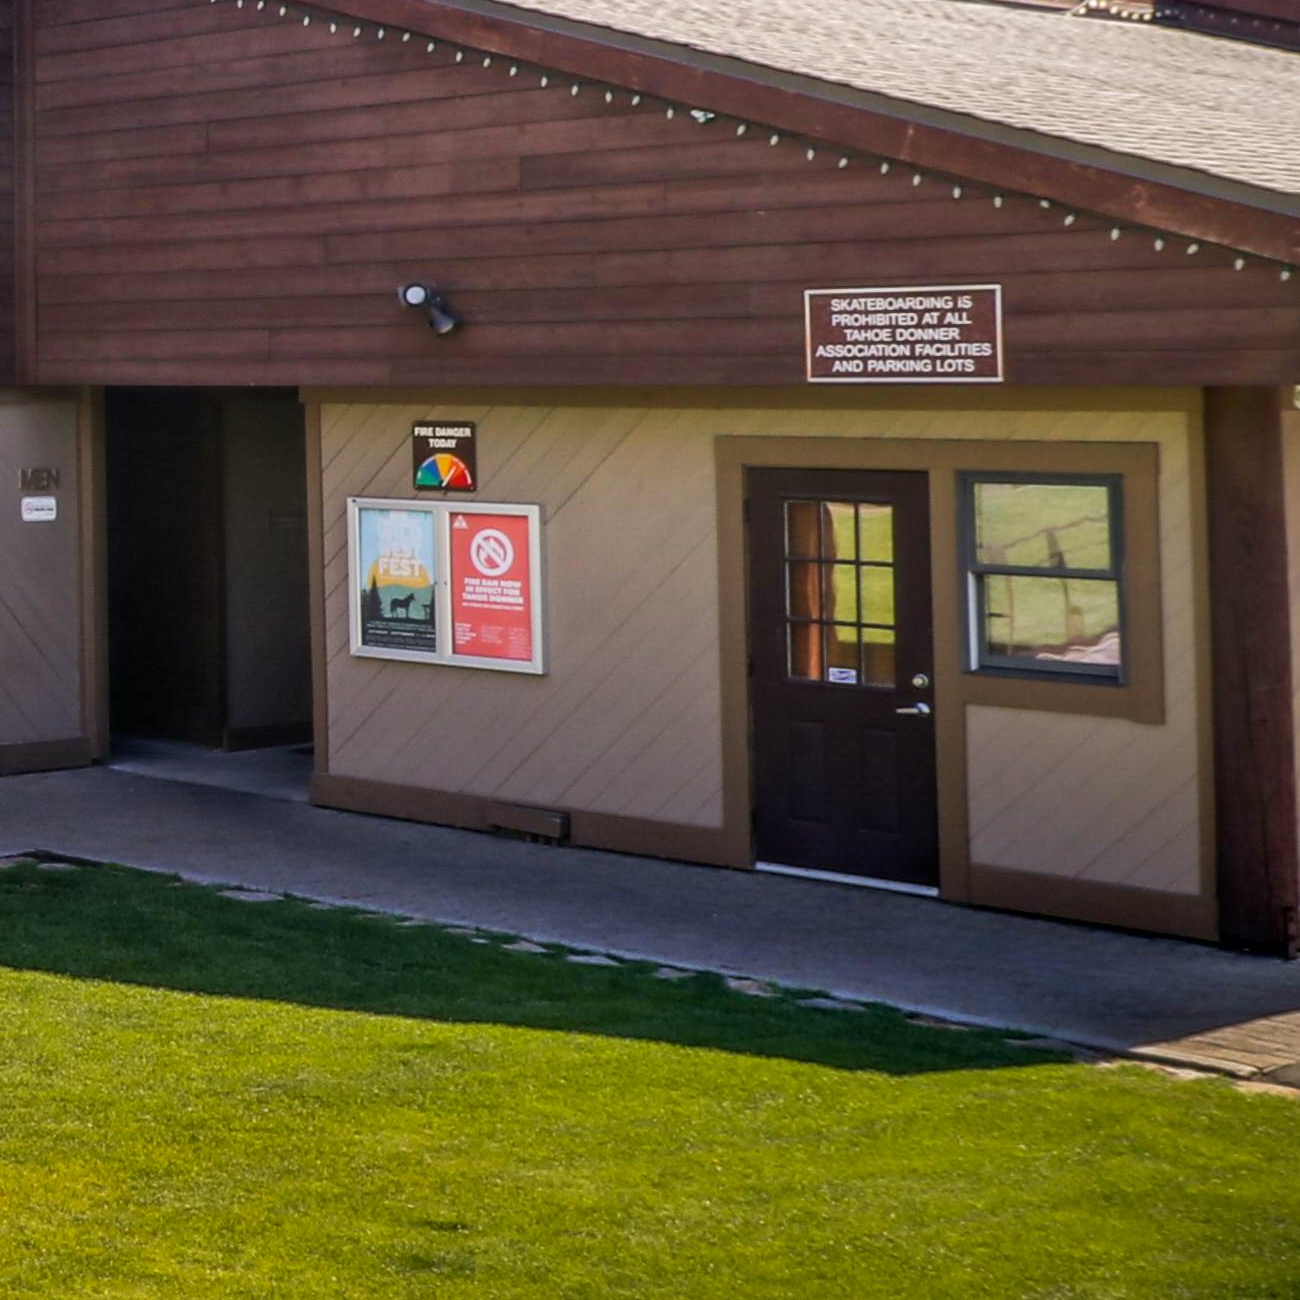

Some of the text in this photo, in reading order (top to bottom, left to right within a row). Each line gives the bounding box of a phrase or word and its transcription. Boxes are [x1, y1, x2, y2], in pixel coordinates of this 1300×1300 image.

[830, 295, 973, 312] SKATEBOARDING IS
[831, 311, 972, 326] PROHIBITED AT ALL
[844, 327, 960, 342] TAHOE DONNER
[815, 342, 992, 358] ASSOCIATION FACILITIES
[832, 359, 975, 373] AND PARKING LOTS
[414, 426, 472, 437] FIRE DANGER
[428, 438, 457, 448] TODAY
[19, 467, 60, 492] MEN
[378, 556, 423, 577] FEST
